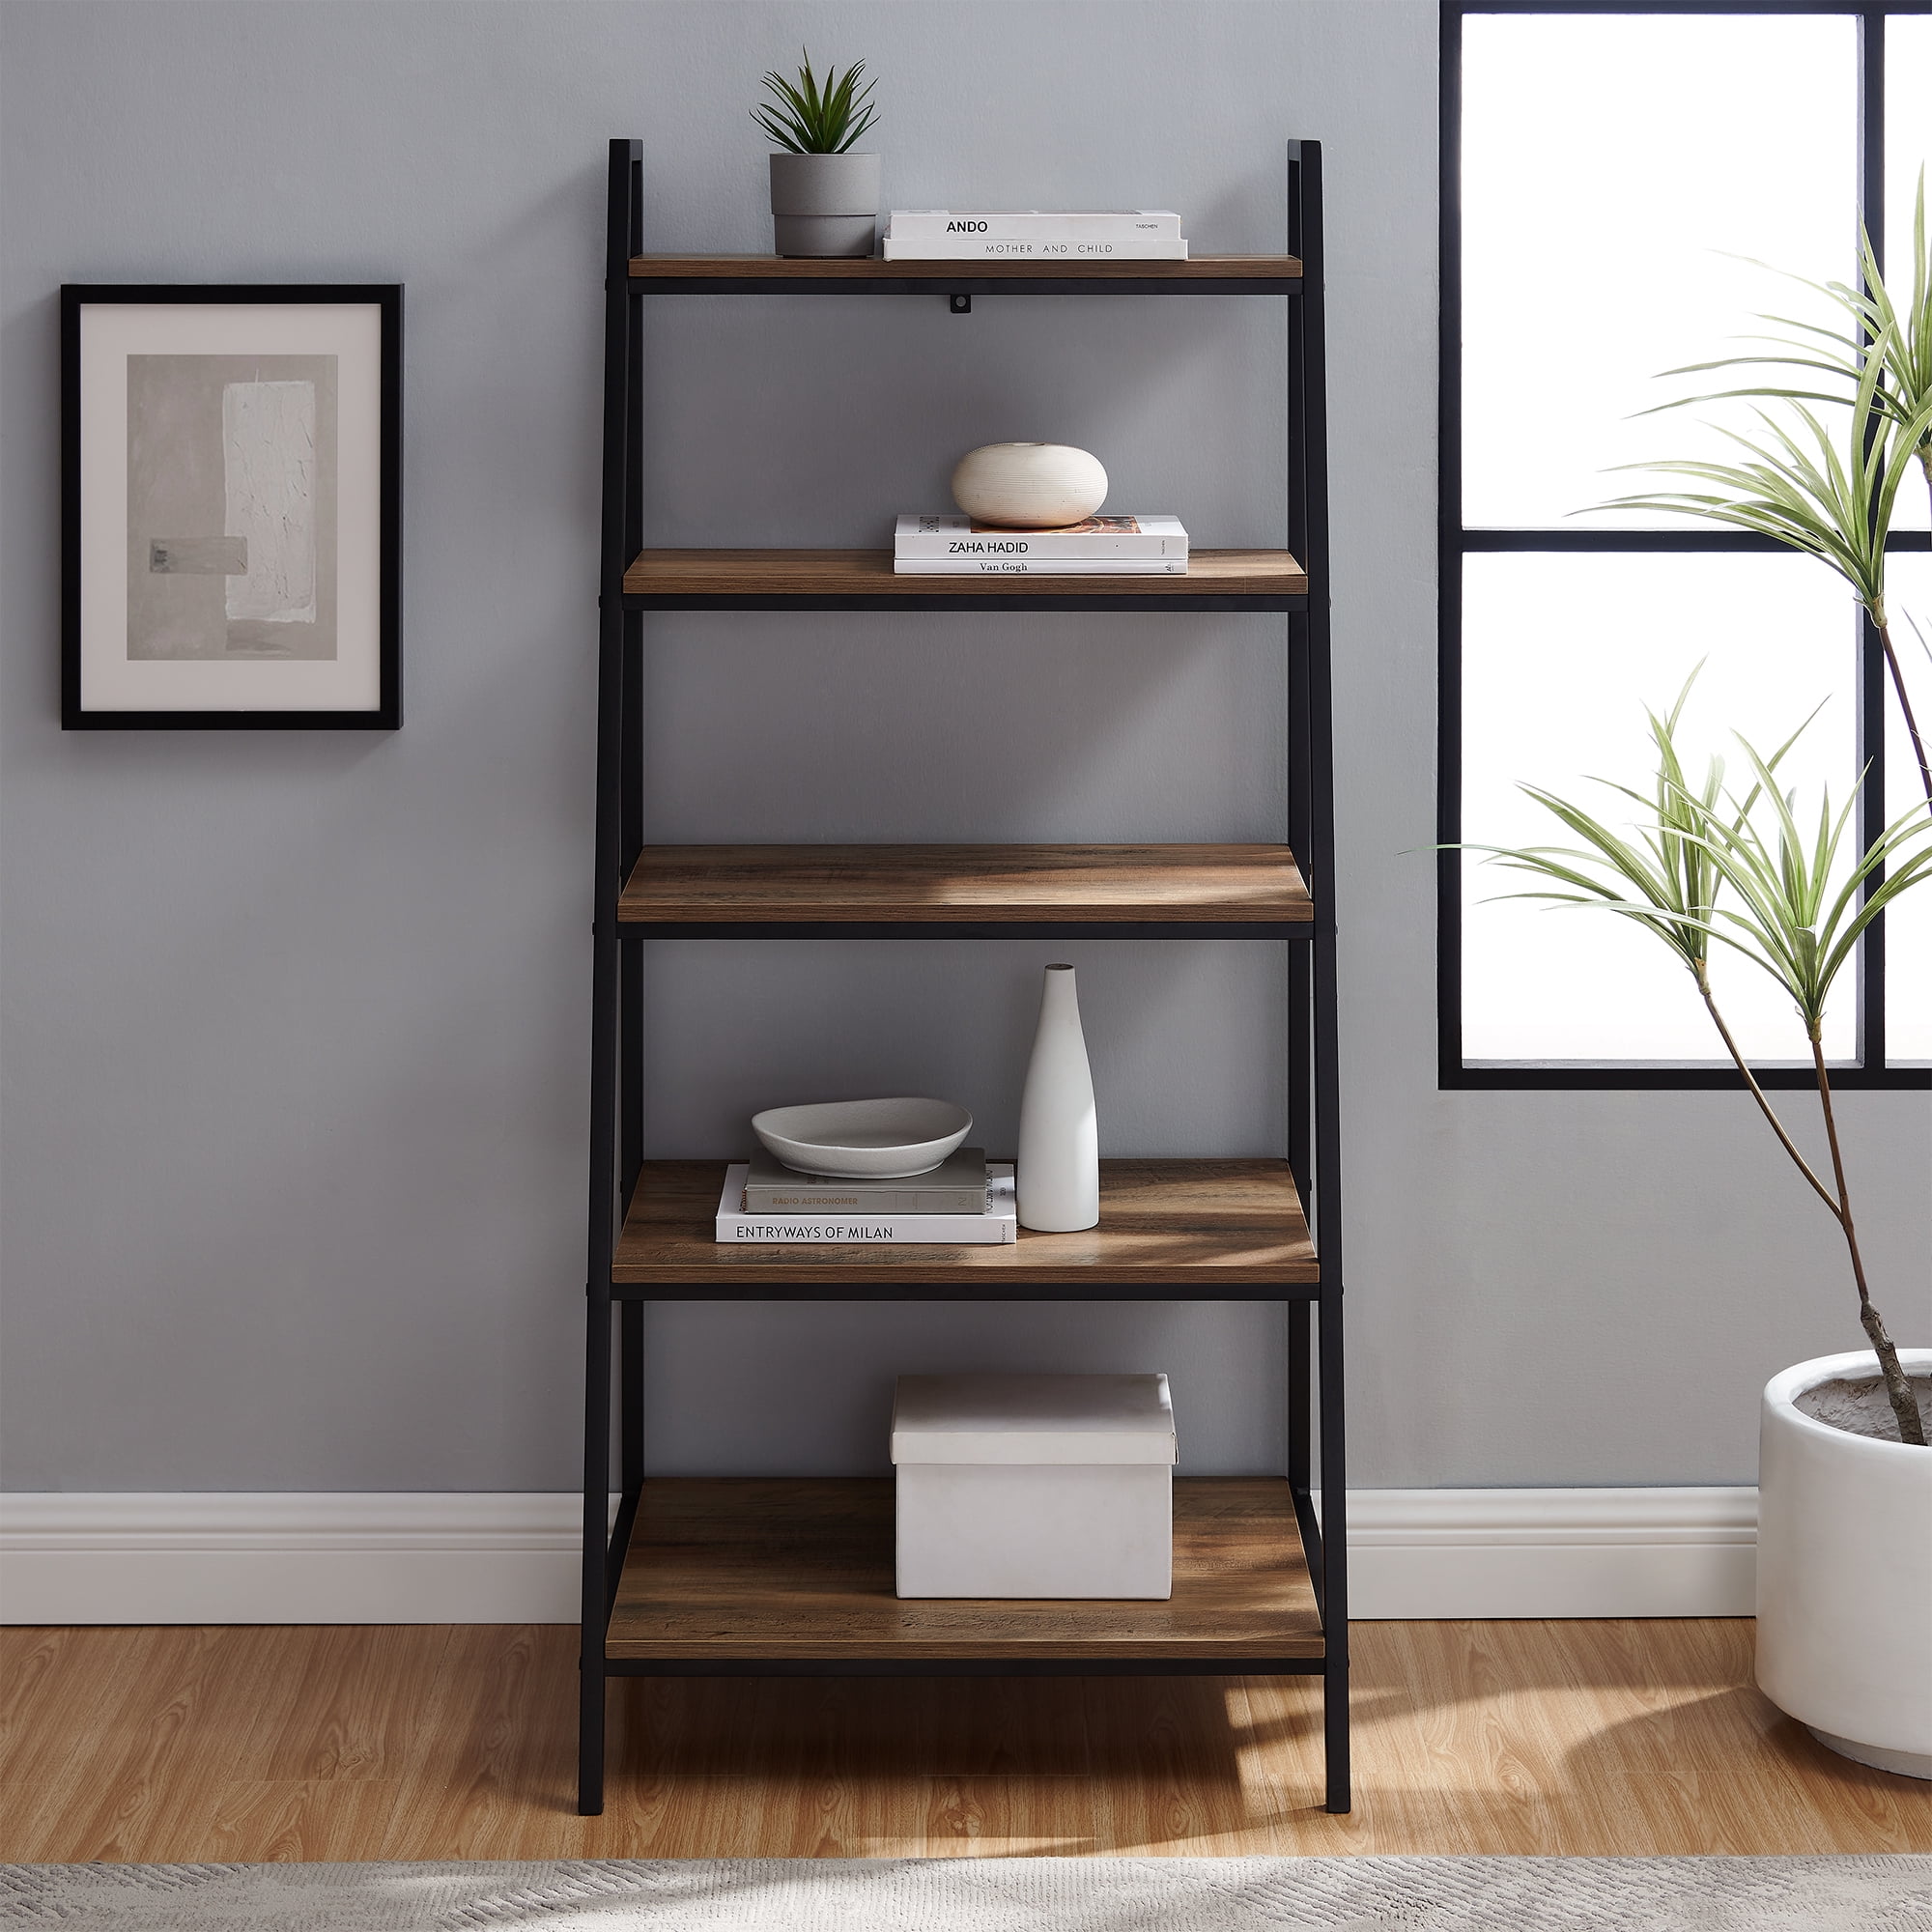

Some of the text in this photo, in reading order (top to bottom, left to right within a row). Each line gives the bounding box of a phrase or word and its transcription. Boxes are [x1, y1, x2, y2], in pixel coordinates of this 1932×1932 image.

[946, 220, 988, 233] ANDO
[985, 244, 1113, 253] MOTHER AND CHILD
[949, 541, 1029, 554] ZAHA HADID
[980, 562, 1028, 573] Van Gogh
[772, 1197, 858, 1207] RADIO ASTRONOMER
[736, 1226, 893, 1239] ENTRYWAYS OF MILAN
